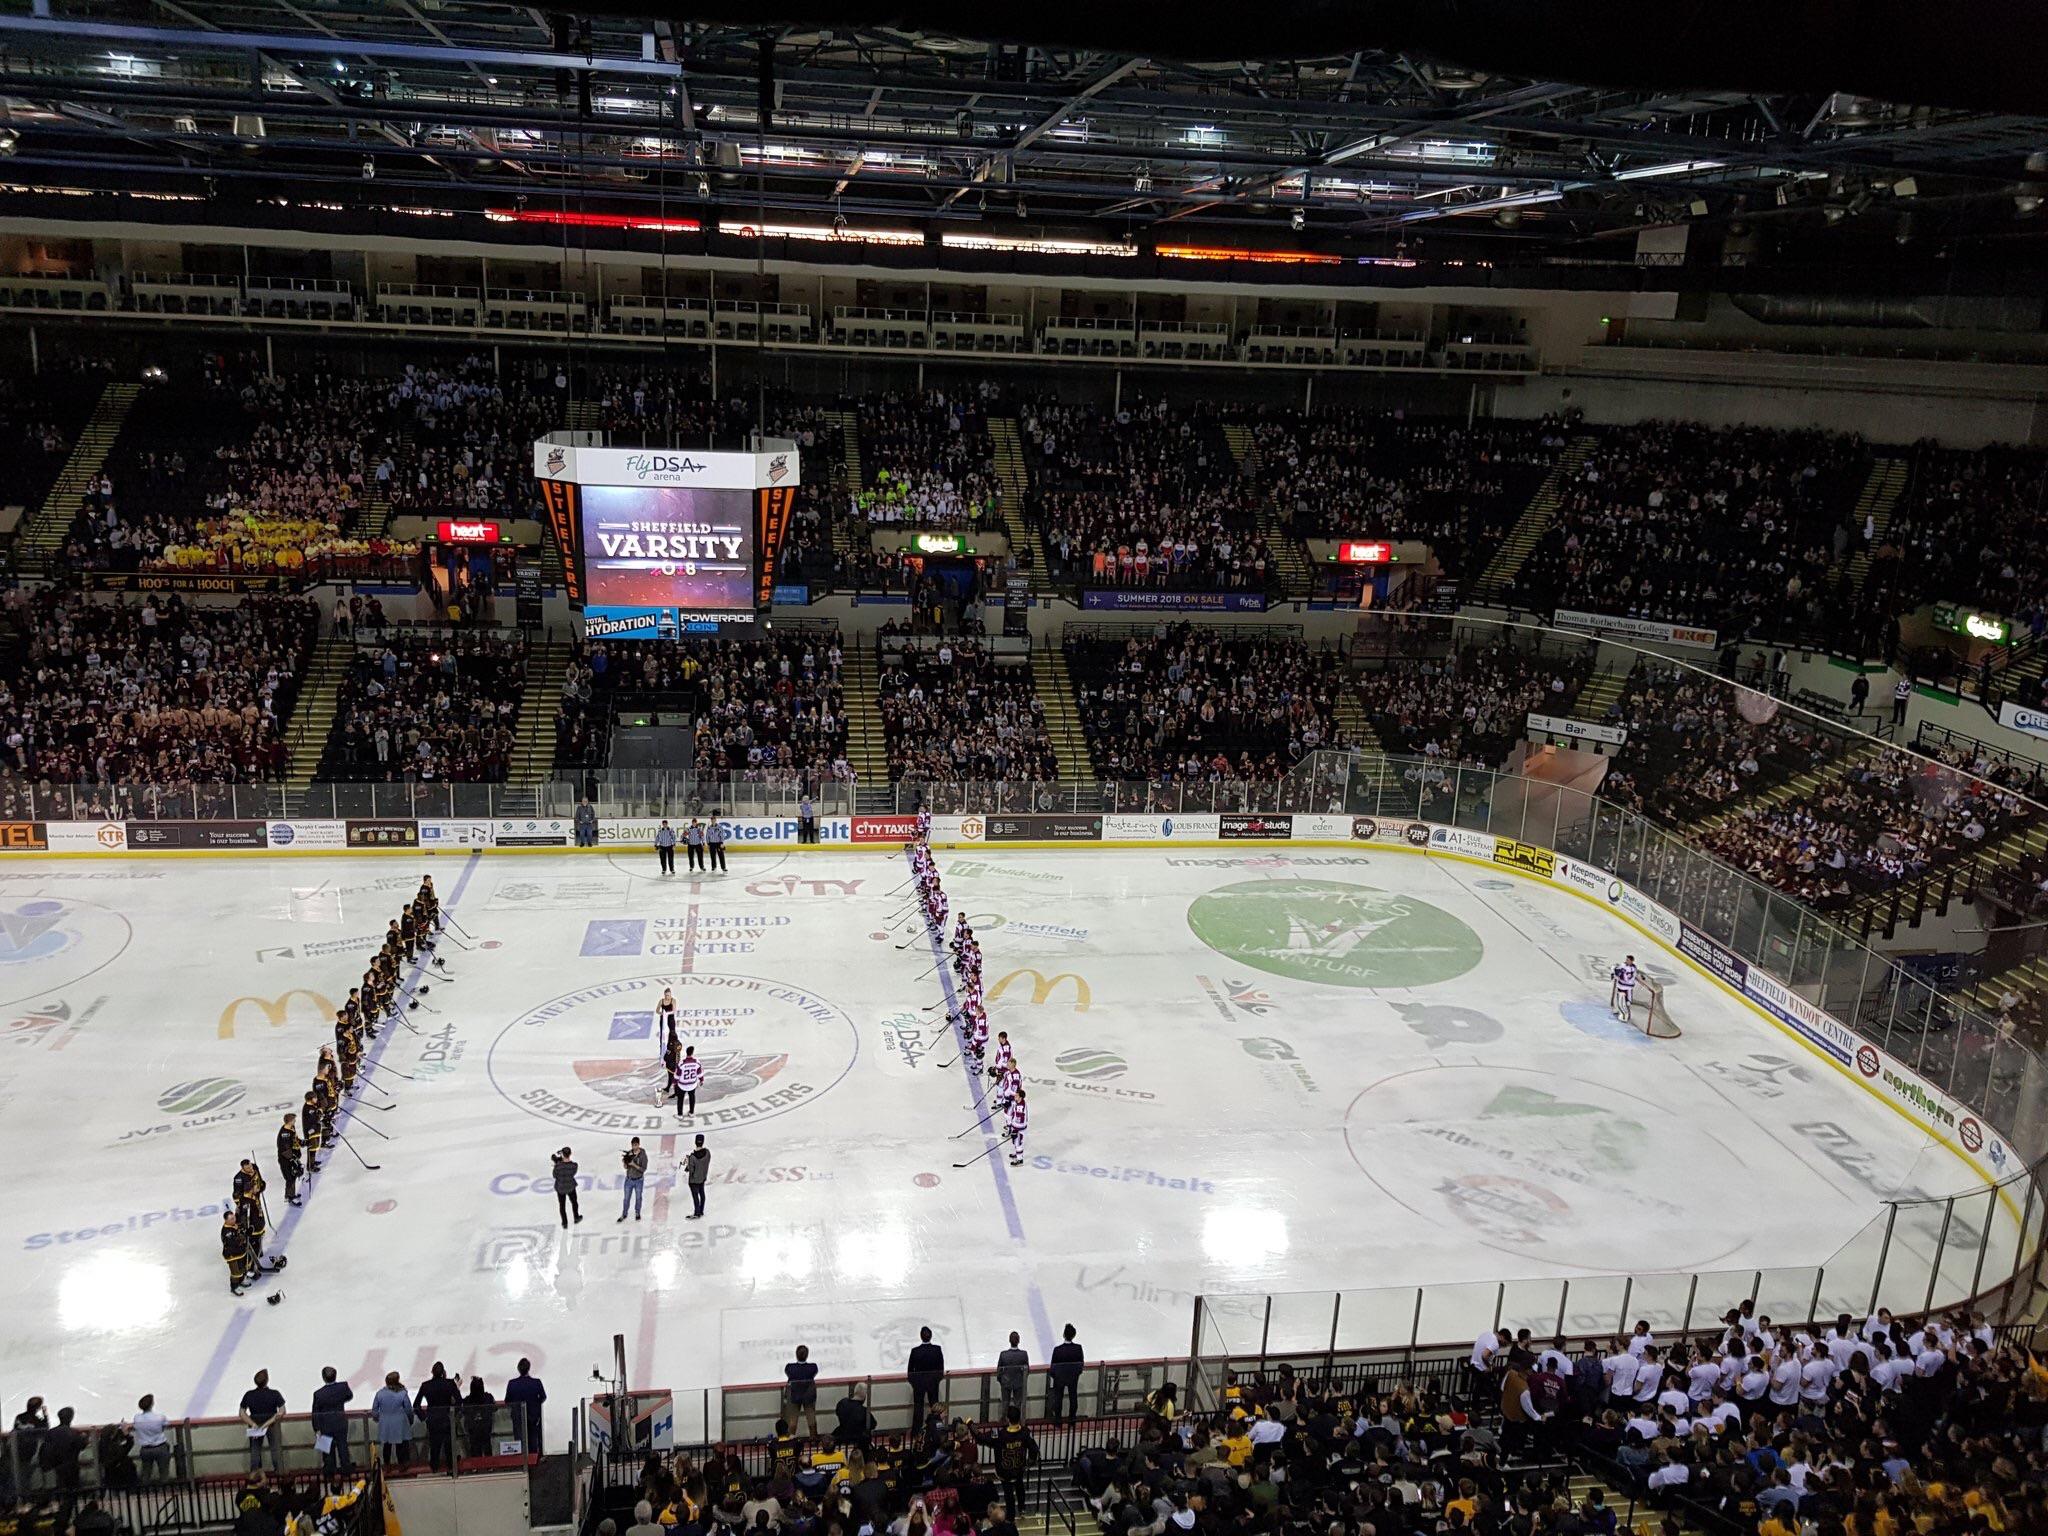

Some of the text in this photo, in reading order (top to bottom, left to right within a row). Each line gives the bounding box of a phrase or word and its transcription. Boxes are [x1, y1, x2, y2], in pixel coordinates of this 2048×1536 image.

[653, 472, 681, 482] arena
[450, 523, 492, 538] heart
[631, 521, 713, 534] SHEFFIELD
[552, 482, 579, 599] STEELERS
[597, 532, 743, 560] VARSITY
[760, 488, 782, 601] STEELERS
[172, 579, 187, 588] FOR
[188, 579, 194, 588] A
[197, 578, 235, 593] HOOCH
[1117, 594, 1225, 604] SUMMER 2018 ON SALE
[585, 616, 606, 625] TOTAL
[585, 615, 655, 636] HYDRATION
[680, 613, 755, 623] POWERADE
[1556, 612, 1588, 624] Thomas
[1589, 616, 1637, 631] Rotherham
[1638, 623, 1671, 636] College
[1565, 723, 1587, 736] Bar
[98, 830, 125, 842] KTR
[721, 821, 849, 840] SteelPalt
[883, 823, 915, 835] TAXIS
[961, 823, 984, 834] KTR
[1312, 824, 1333, 832] eden
[1449, 832, 1462, 844] A1
[1466, 841, 1492, 851] SYSTEMS
[1467, 835, 1481, 843] FLUE
[1431, 843, 1491, 858] www.a1flues.co.uk
[987, 865, 1064, 882] Holiday Inn
[1570, 873, 1594, 889] Homes
[1571, 863, 1606, 885] Keepmoat
[1294, 884, 1413, 918] SYKES
[653, 916, 792, 929] SHEFFIELD
[1008, 921, 1089, 938] Sheffield
[1650, 912, 1674, 936] UNISON
[303, 934, 385, 950] Keepmo
[654, 928, 768, 941] WINDOW
[305, 942, 376, 958] Homes
[649, 941, 756, 955] CENTRE
[1682, 928, 1734, 967] ESSENTIAL COVER
[1236, 943, 1381, 979] LAWNTURF
[1682, 936, 1743, 984] WHEREVER YOU WORK
[523, 979, 647, 1027] SHEFFIELD
[646, 976, 767, 992] WINDOW
[673, 1007, 755, 1017] HEFFIELD
[1749, 970, 1787, 1006] SHEFFIELD
[1789, 995, 1822, 1027] WINDOW
[1823, 1020, 1856, 1052] CENTRE
[883, 1031, 896, 1051] arena
[683, 1069, 697, 1081] 22
[1064, 1081, 1108, 1094] (UK)
[1115, 1088, 1156, 1100] LTD
[520, 1081, 815, 1130] SHEFFIELD STEELERS
[118, 1102, 294, 1140] JVS (UK) LTD
